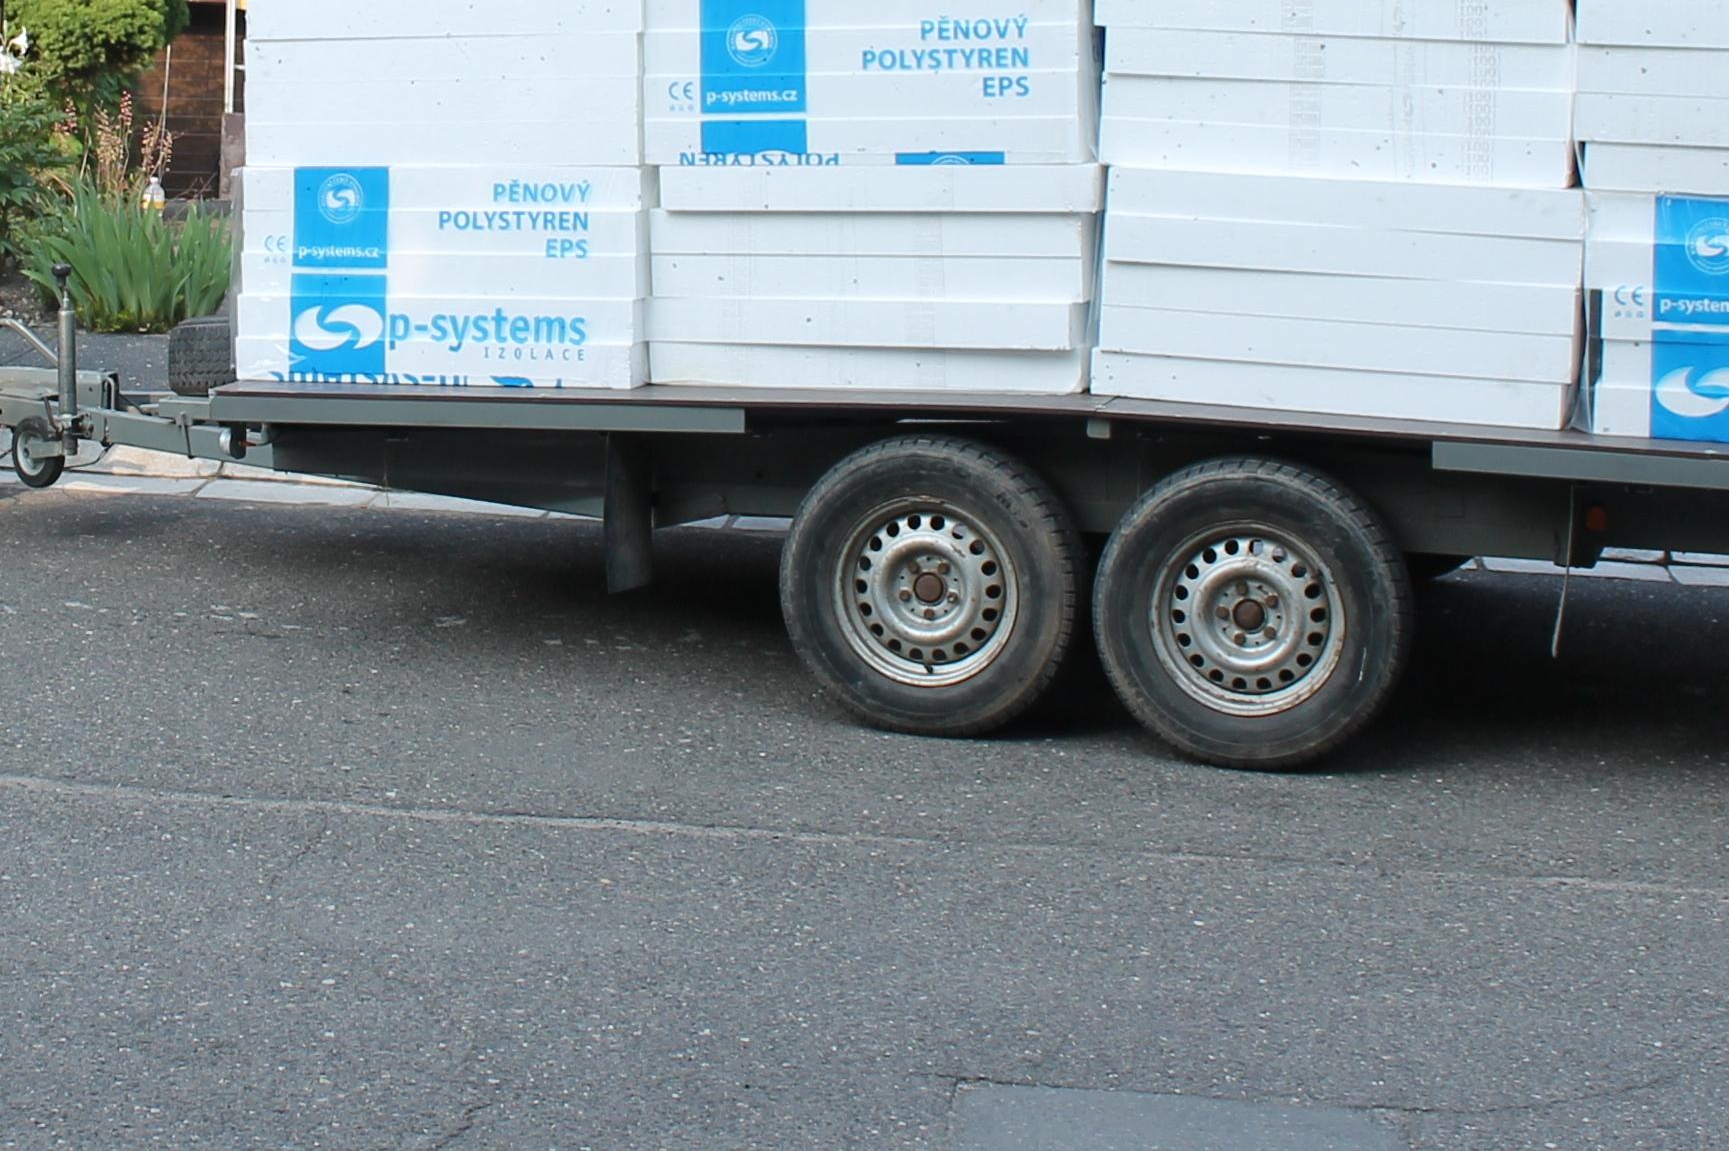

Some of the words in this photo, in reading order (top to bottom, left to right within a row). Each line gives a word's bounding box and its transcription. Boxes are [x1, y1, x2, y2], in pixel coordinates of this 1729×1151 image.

[921, 14, 1028, 40] PĚNOVÝ
[862, 47, 1029, 70] POLYSTYREN
[706, 89, 798, 105] p-systems.cz
[982, 76, 1029, 97] EPS
[493, 180, 590, 203] PĚNOVÝ
[439, 211, 588, 231] POLYSTYREN
[299, 245, 379, 259] p-systems.cz
[545, 238, 587, 259] EPS
[389, 307, 586, 352] p-systems
[484, 347, 585, 361] IZOLACE
